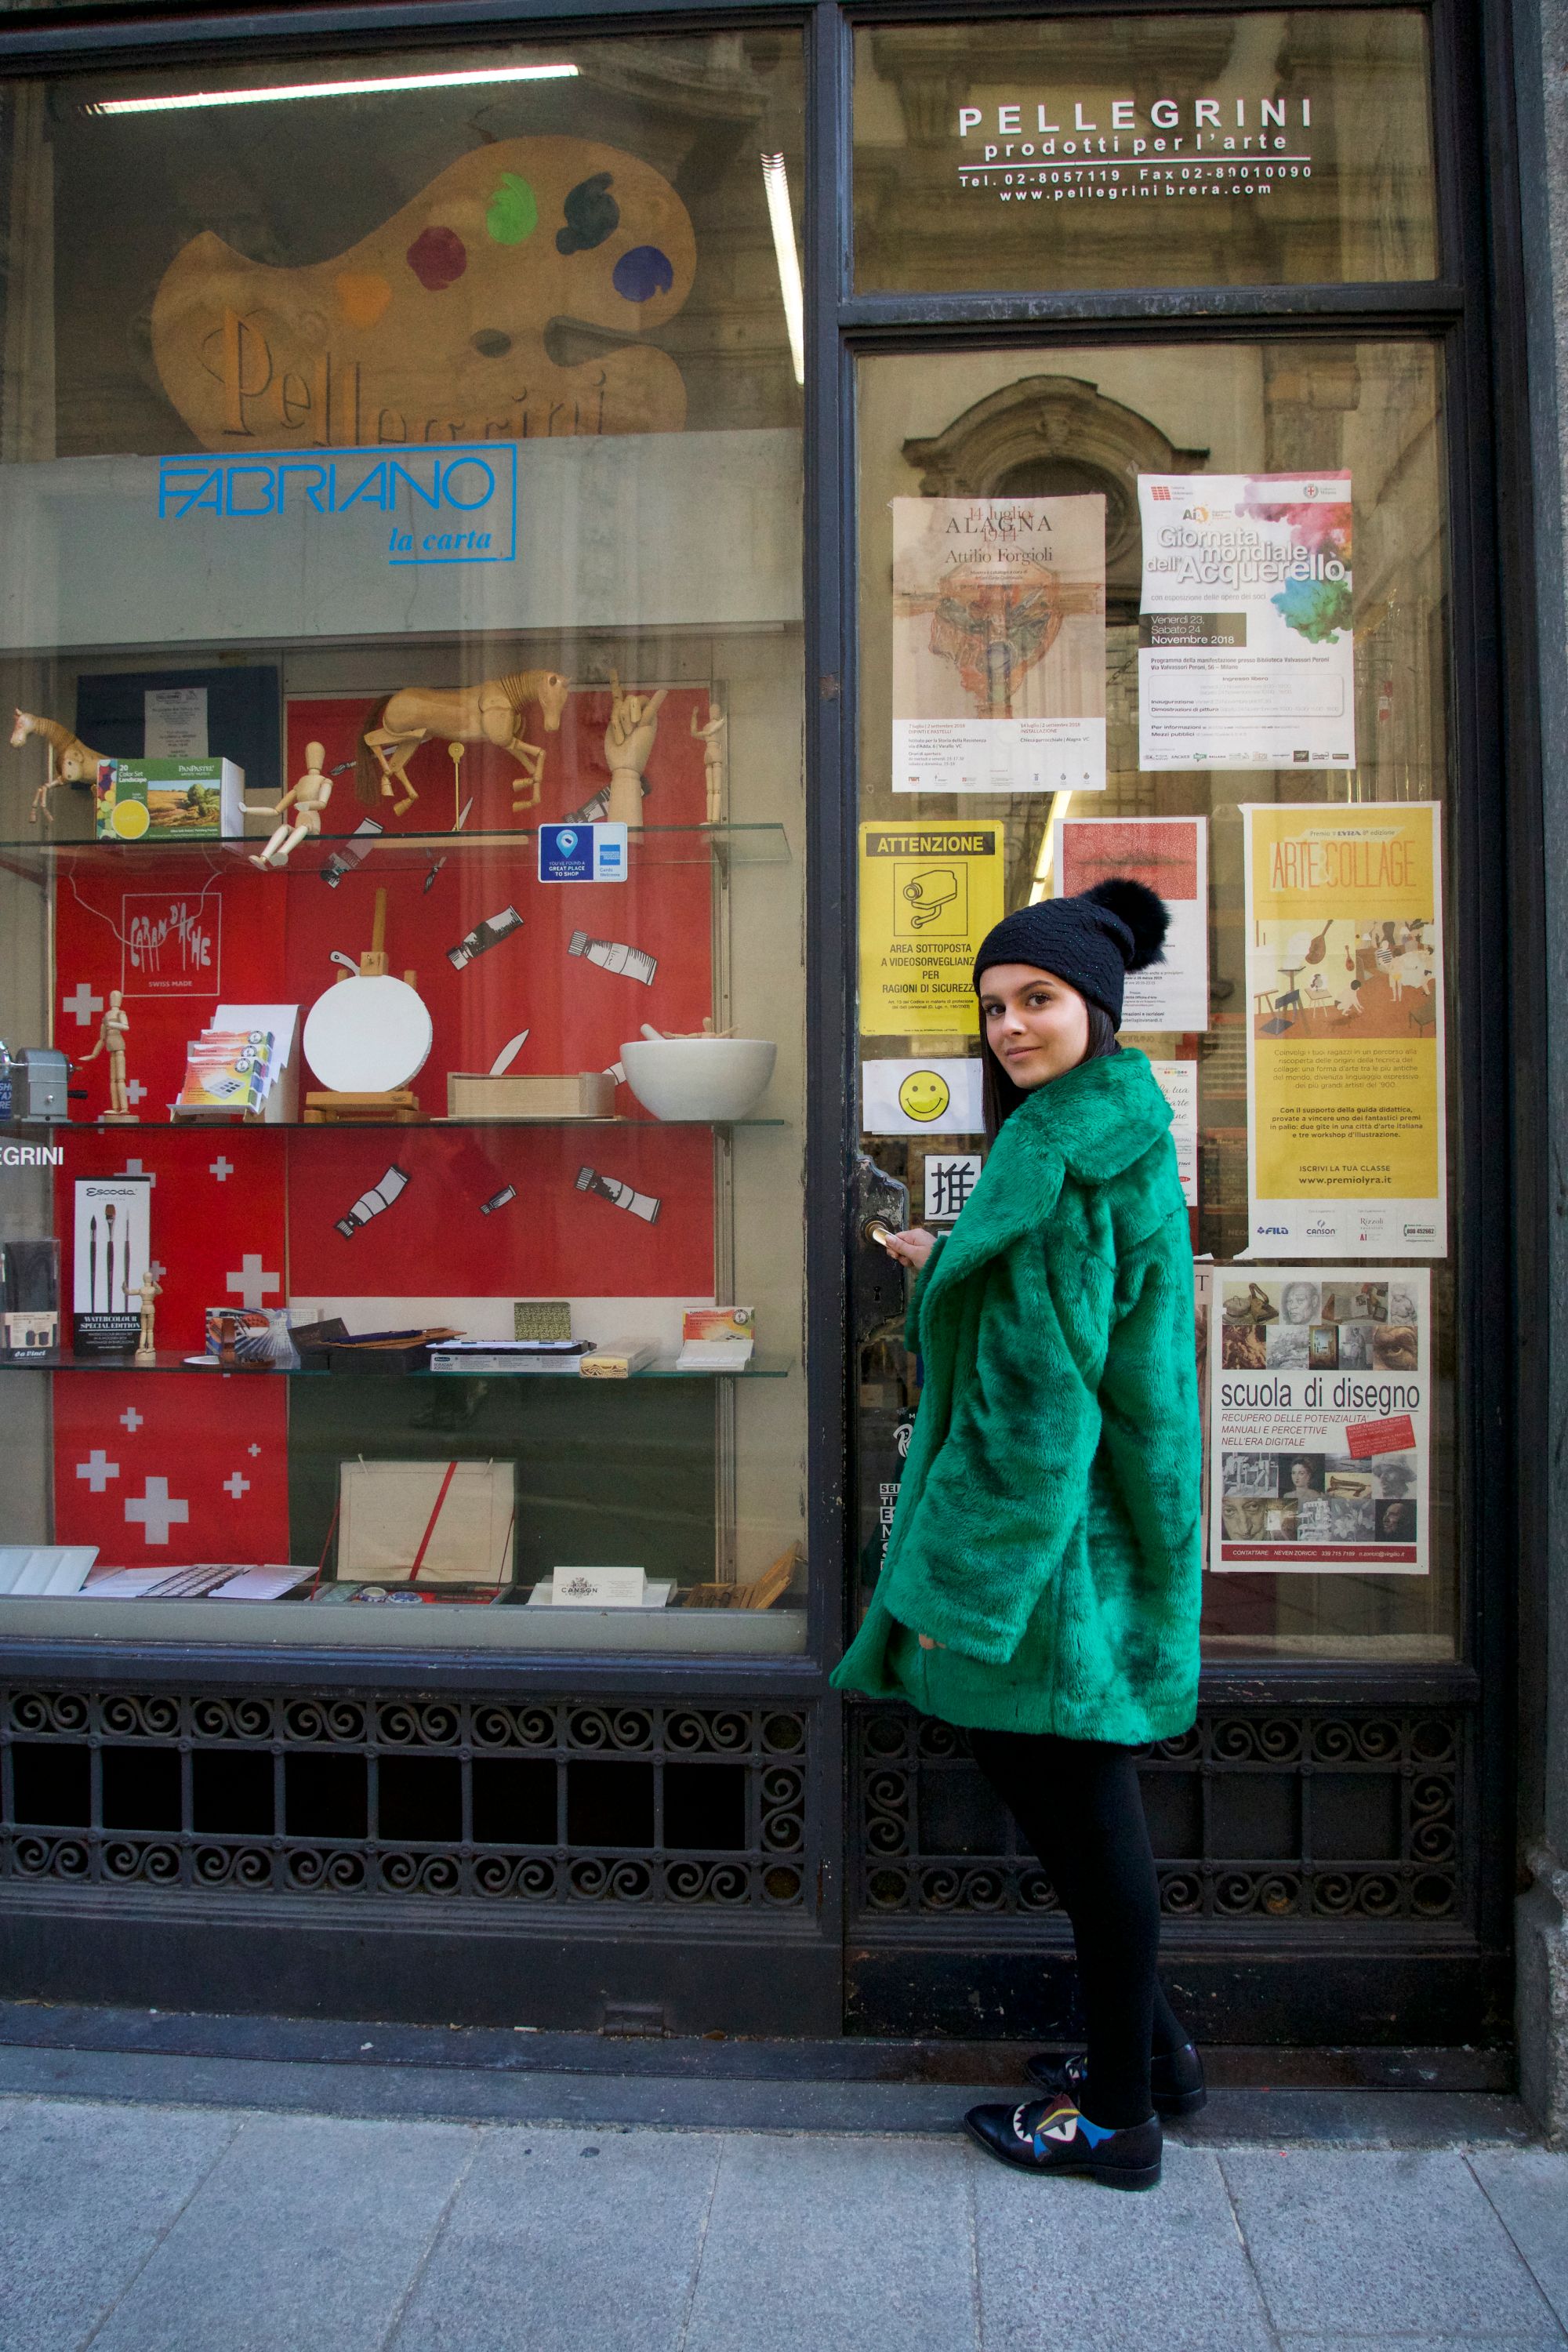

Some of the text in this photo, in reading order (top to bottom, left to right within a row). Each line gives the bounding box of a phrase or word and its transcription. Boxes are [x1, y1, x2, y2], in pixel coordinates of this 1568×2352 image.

[959, 100, 1311, 137] PELLEGRINI
[985, 136, 1120, 161] prodotti
[1134, 135, 1183, 155] per
[960, 175, 996, 187] Tel.
[1004, 170, 1120, 185] 02-8057119
[1140, 169, 1174, 180] Fax
[1000, 185, 1271, 201] www.pellegrinibrera.com
[159, 457, 495, 518] FABRIANO
[946, 515, 1053, 534] ALAGNA
[389, 528, 492, 551] la carta
[1157, 526, 1259, 547] Giornata
[945, 547, 1053, 565] Attilio Forgioli
[1200, 542, 1308, 562] mondiale
[1151, 615, 1189, 624] Venerdì
[1151, 626, 1187, 634] Sabato
[1152, 636, 1235, 644] Novembre 2018
[877, 837, 984, 852] ATTENZIONE
[1272, 840, 1417, 888] ARTE COLLAGE
[890, 944, 971, 953] AREA SOTTOPOSTA
[881, 957, 975, 967] A VIDEOSORVEGLIANZ
[922, 971, 939, 979] PER
[882, 984, 975, 993] RAGIONI DI SICUREZZ
[1299, 1175, 1392, 1185] www.premiolyra.it
[86, 1187, 136, 1196] Escoda
[929, 1162, 975, 1215] 推
[1221, 1377, 1420, 1416] scuola di disegno
[1221, 1414, 1272, 1422] RECUPERO
[1274, 1414, 1301, 1422] DELLE
[1221, 1425, 1261, 1434] MANUALI
[1271, 1426, 1327, 1435] PERCETTIVE
[1221, 1437, 1305, 1446] NELL'ERA DIGITALE
